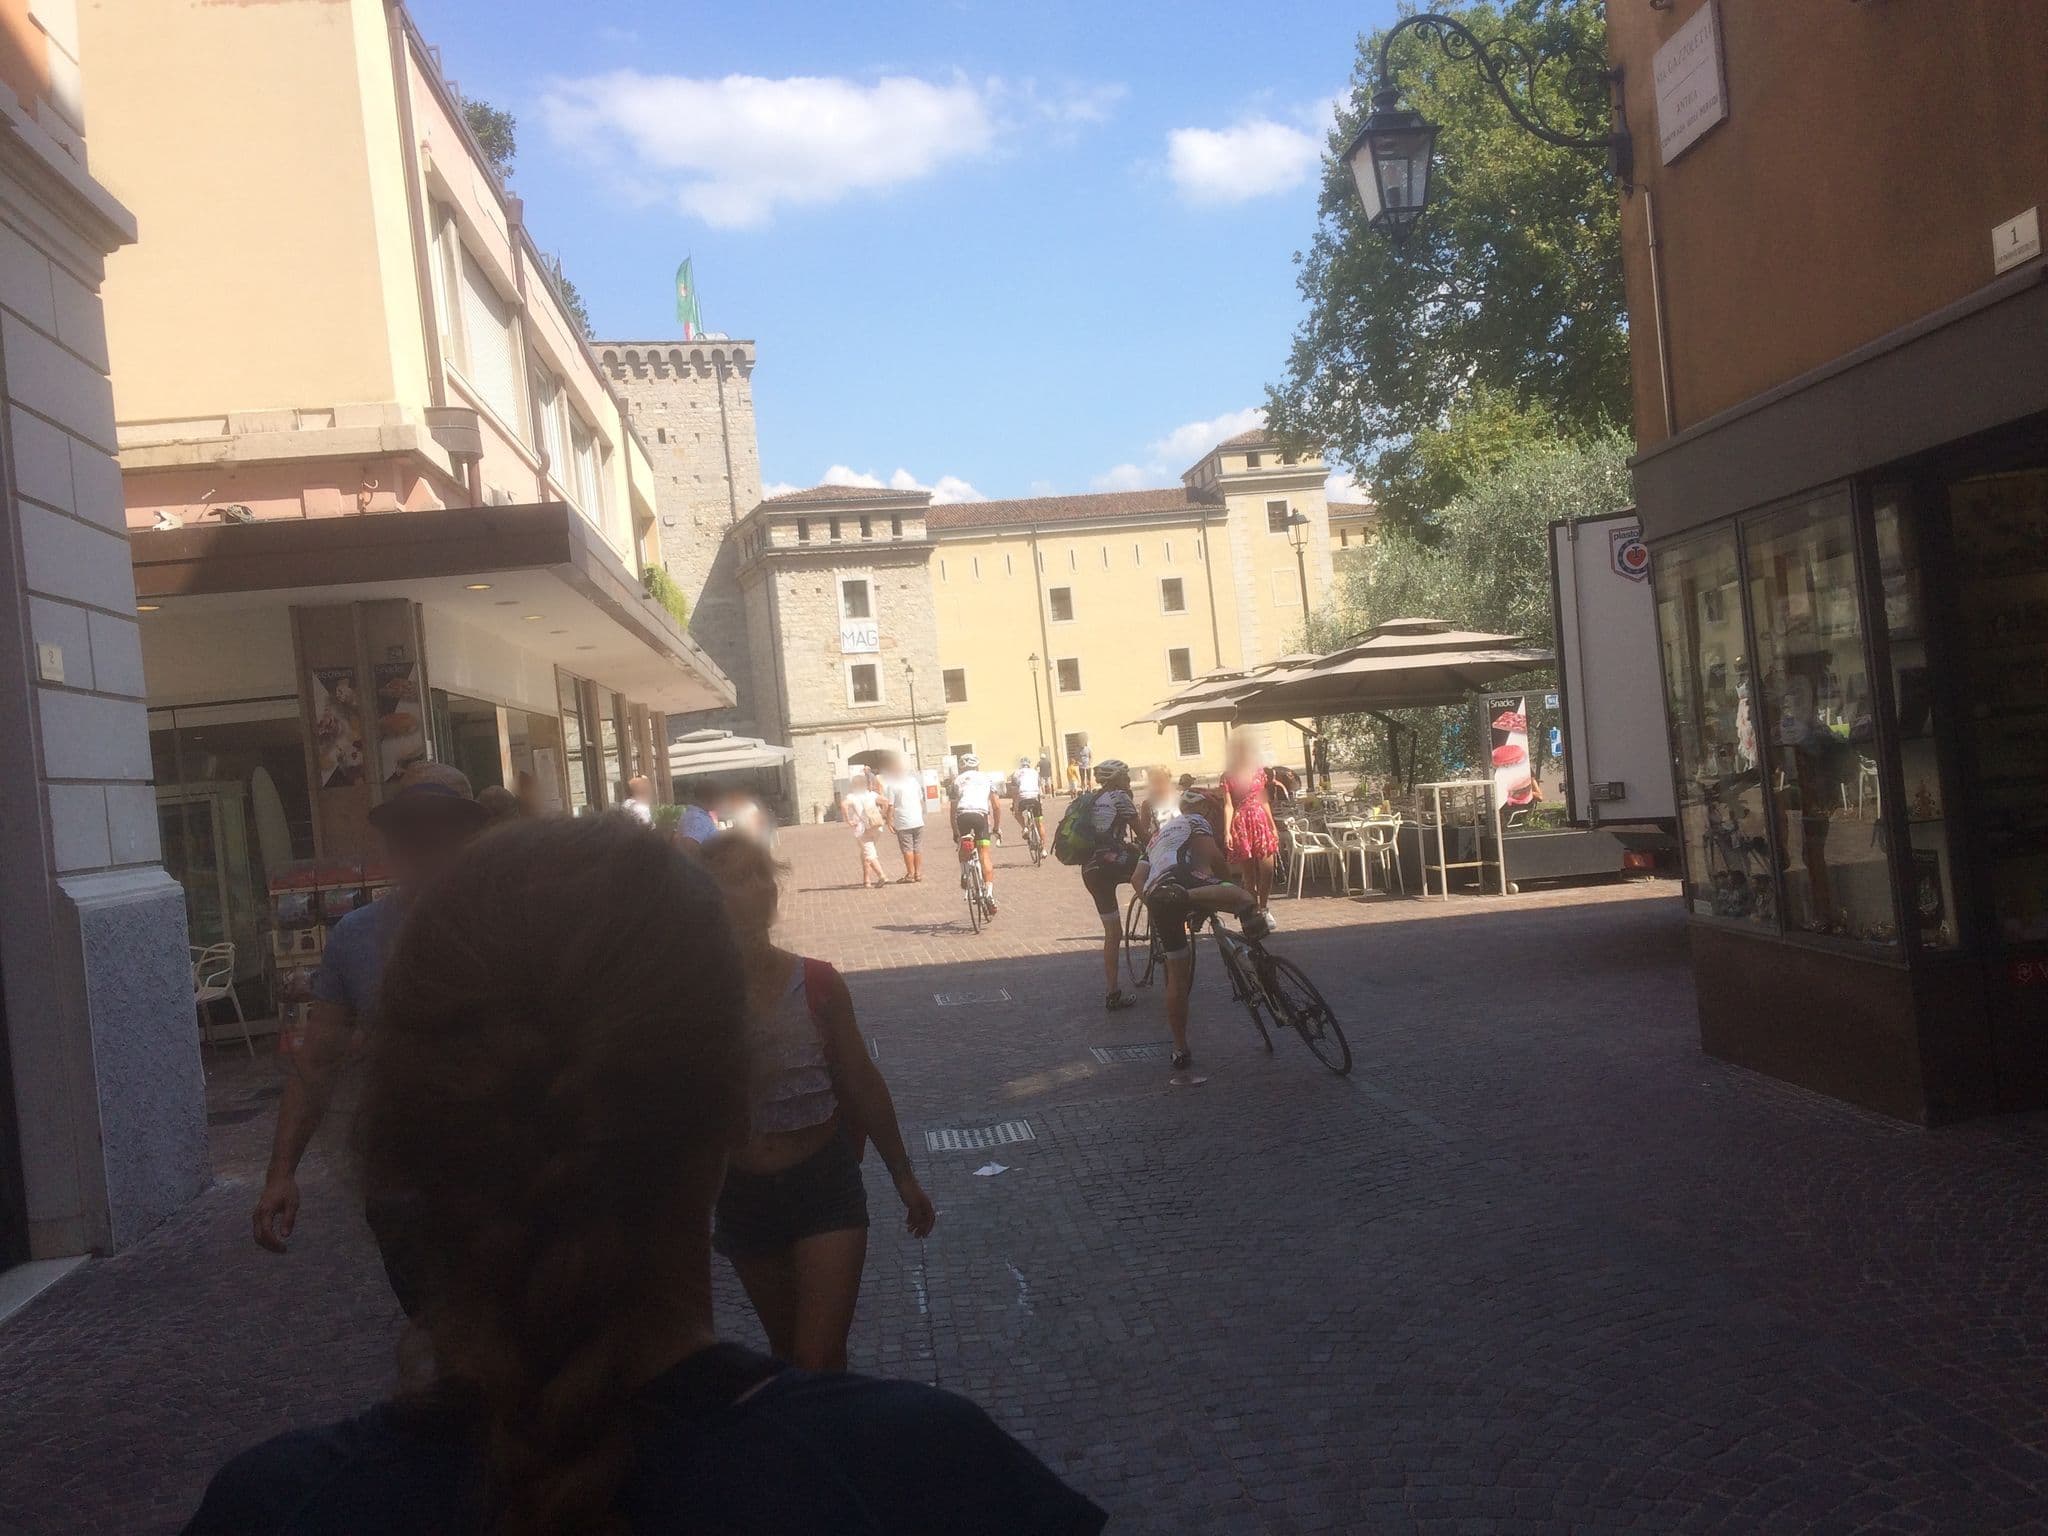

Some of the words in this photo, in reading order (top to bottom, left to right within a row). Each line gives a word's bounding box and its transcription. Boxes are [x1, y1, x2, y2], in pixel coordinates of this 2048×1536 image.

[2011, 226, 2019, 245] 1
[1614, 530, 1640, 541] plasto
[842, 630, 878, 648] MAG
[1490, 699, 1515, 709] Snacks
